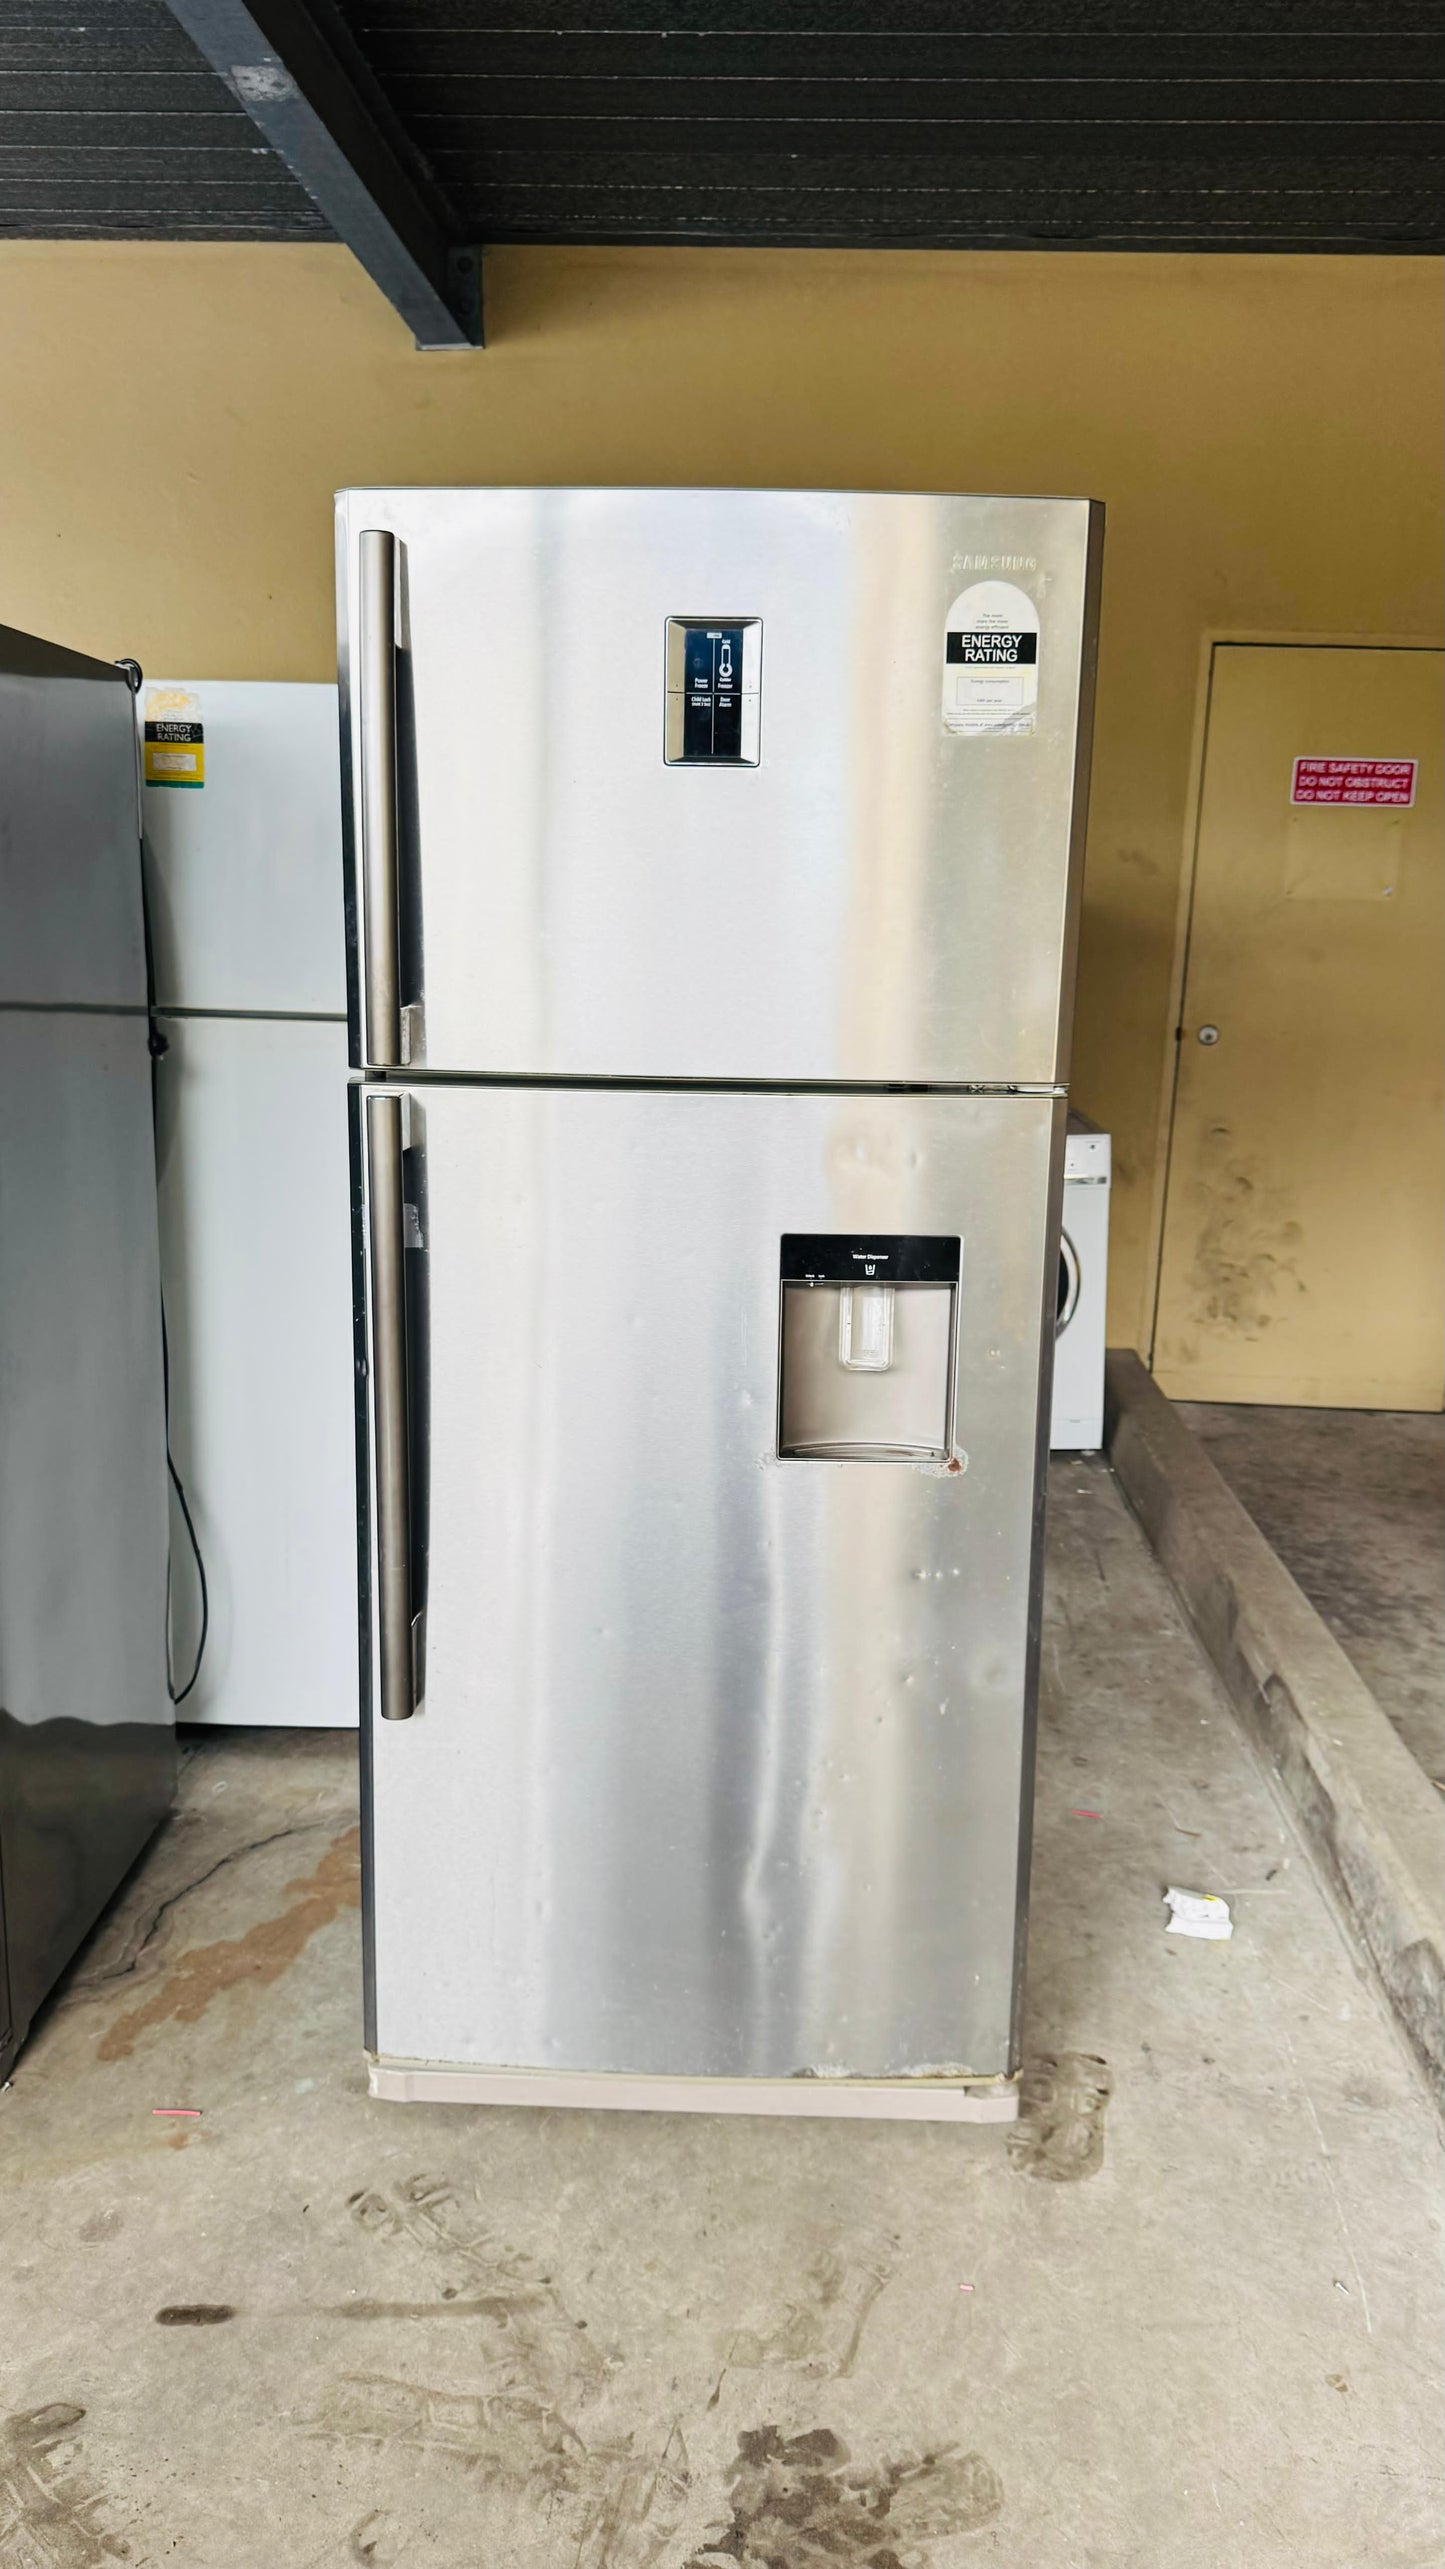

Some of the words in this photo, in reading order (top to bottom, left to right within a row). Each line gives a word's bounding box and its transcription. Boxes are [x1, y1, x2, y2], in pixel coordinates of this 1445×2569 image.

[961, 634, 1023, 648] ENERGY
[965, 648, 1018, 662] RATING
[156, 723, 192, 733] ENERGY
[157, 732, 192, 742] RATING
[1299, 761, 1326, 773] FIRE
[1328, 762, 1375, 774] SAFETY
[1375, 763, 1411, 775] DOOR
[1298, 775, 1318, 786] DO
[1318, 776, 1344, 787] NOT
[1345, 777, 1409, 789] OBSTRUCT
[1296, 789, 1315, 800] DO
[1316, 790, 1341, 800] NOT
[1342, 791, 1375, 802] KEEP
[1376, 792, 1409, 803] OPEN
